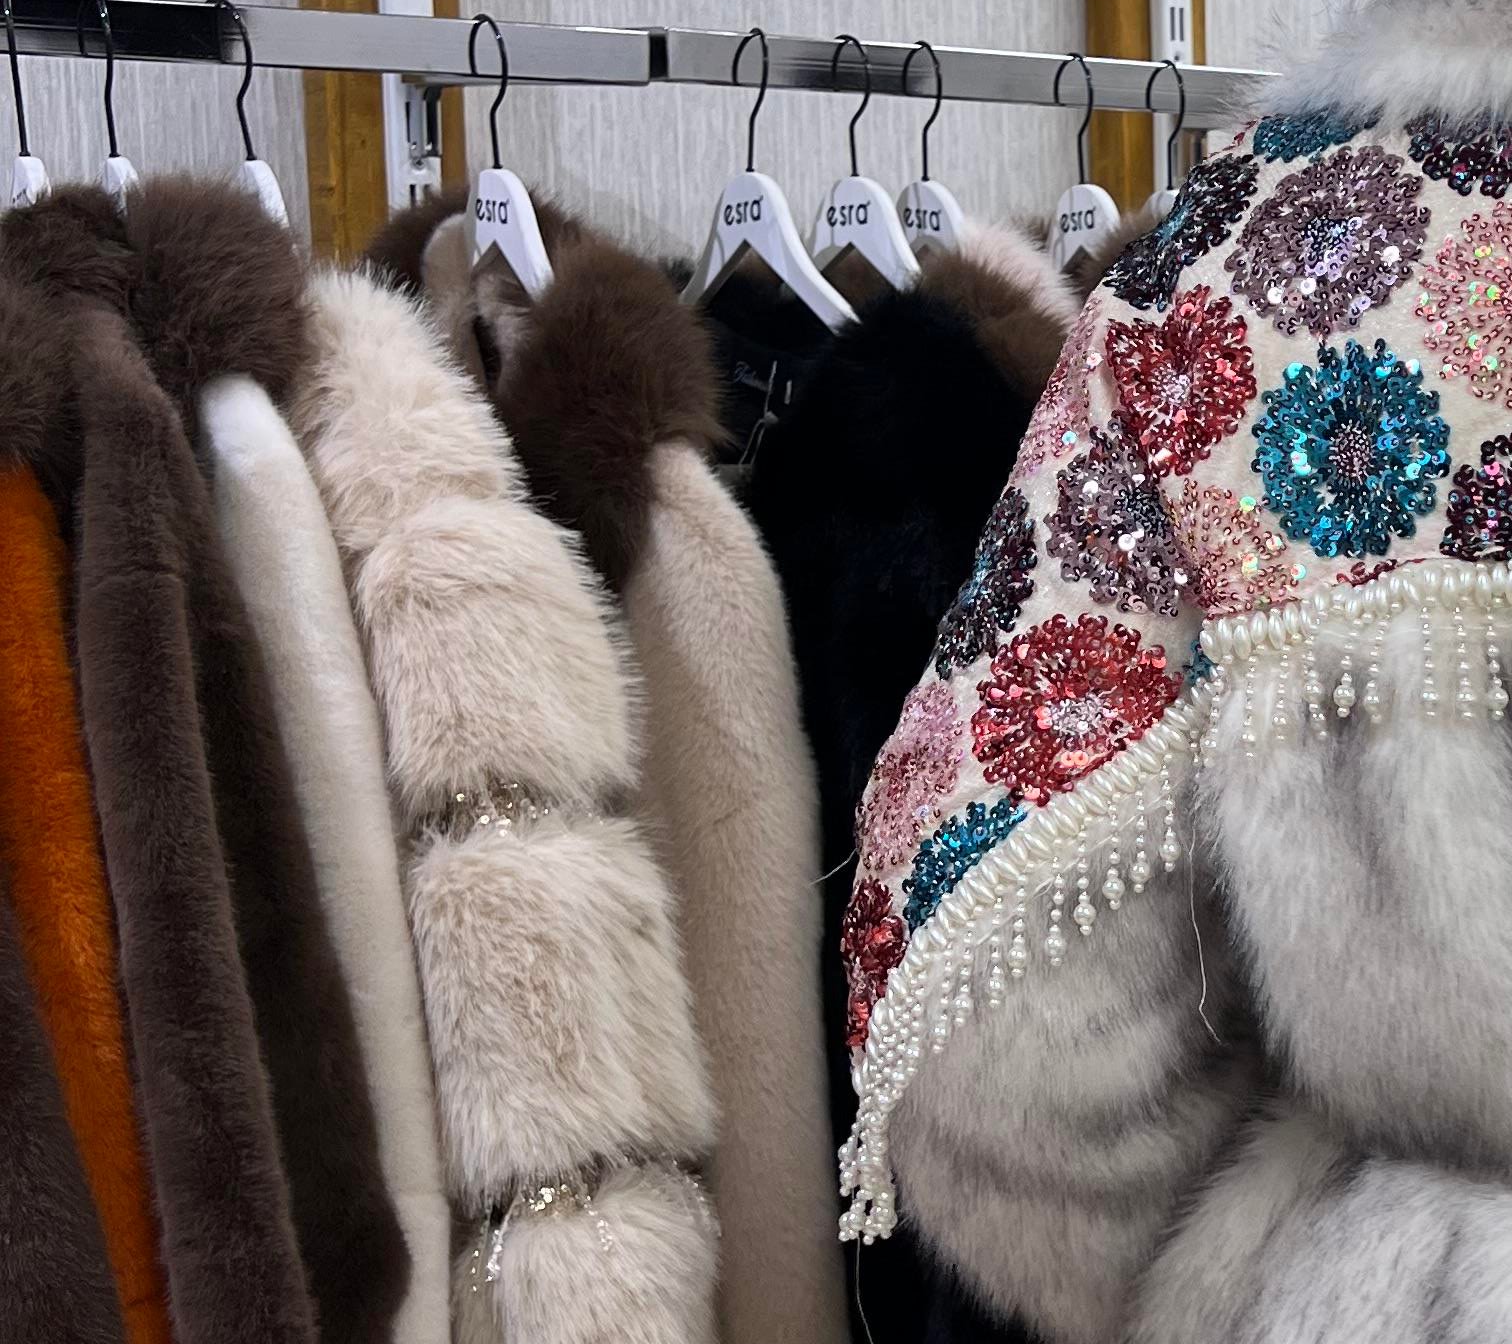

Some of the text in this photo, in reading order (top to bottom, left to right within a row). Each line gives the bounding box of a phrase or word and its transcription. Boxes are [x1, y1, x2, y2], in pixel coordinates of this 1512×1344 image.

[475, 198, 509, 224] esra
[724, 195, 763, 226] esra
[826, 201, 871, 227] esra
[903, 206, 941, 232] esra
[1060, 207, 1096, 233] esra
